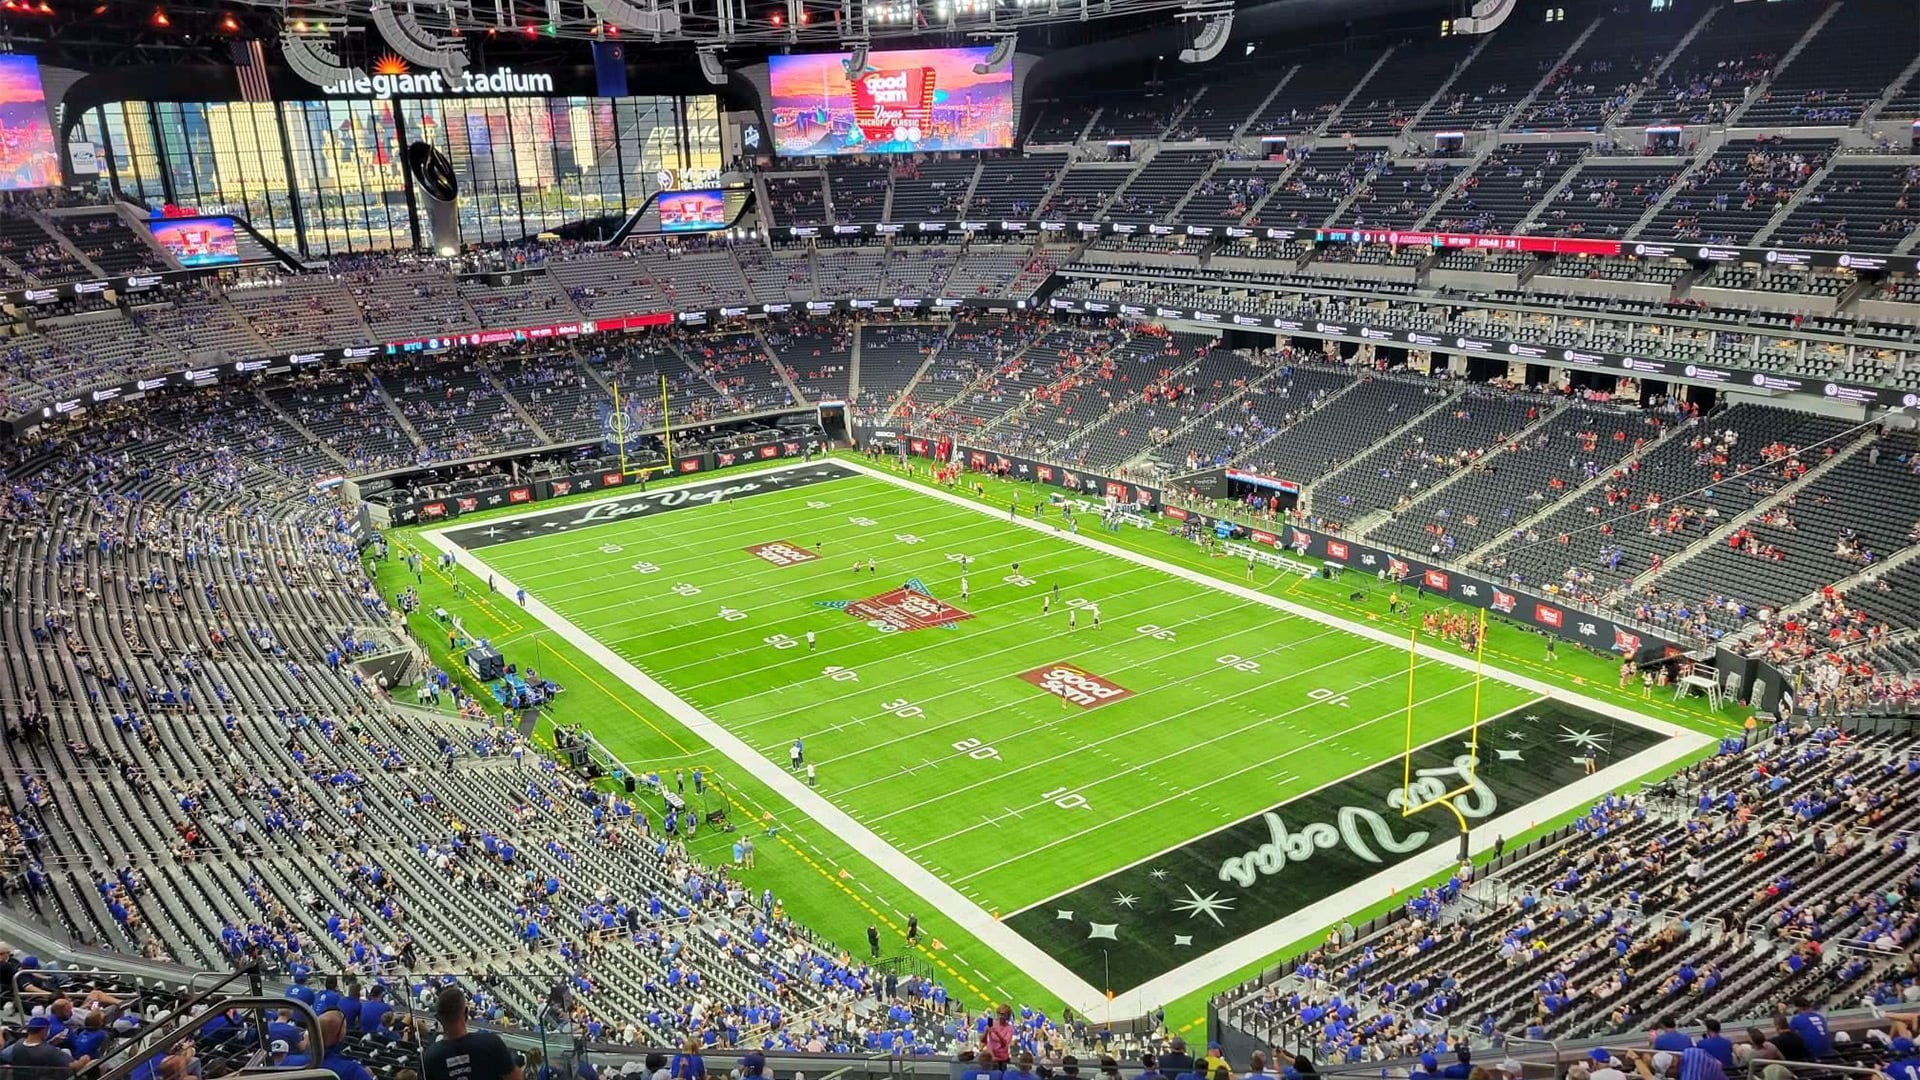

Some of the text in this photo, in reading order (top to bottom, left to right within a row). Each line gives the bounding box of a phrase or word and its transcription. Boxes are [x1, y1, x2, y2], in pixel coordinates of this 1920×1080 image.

[451, 66, 554, 93] tadium
[866, 71, 907, 95] good
[874, 90, 908, 102] sam
[873, 105, 904, 119] Vegas
[198, 205, 229, 215] LIGHT
[570, 483, 761, 525] Las Vegas
[763, 633, 798, 650] 50
[822, 665, 855, 681] 40
[1042, 668, 1125, 698] good
[1039, 680, 1097, 706] sam
[881, 699, 922, 719] 30
[952, 738, 998, 760] 20
[1040, 787, 1088, 809] 10
[1218, 754, 1498, 888] Las Vegas
